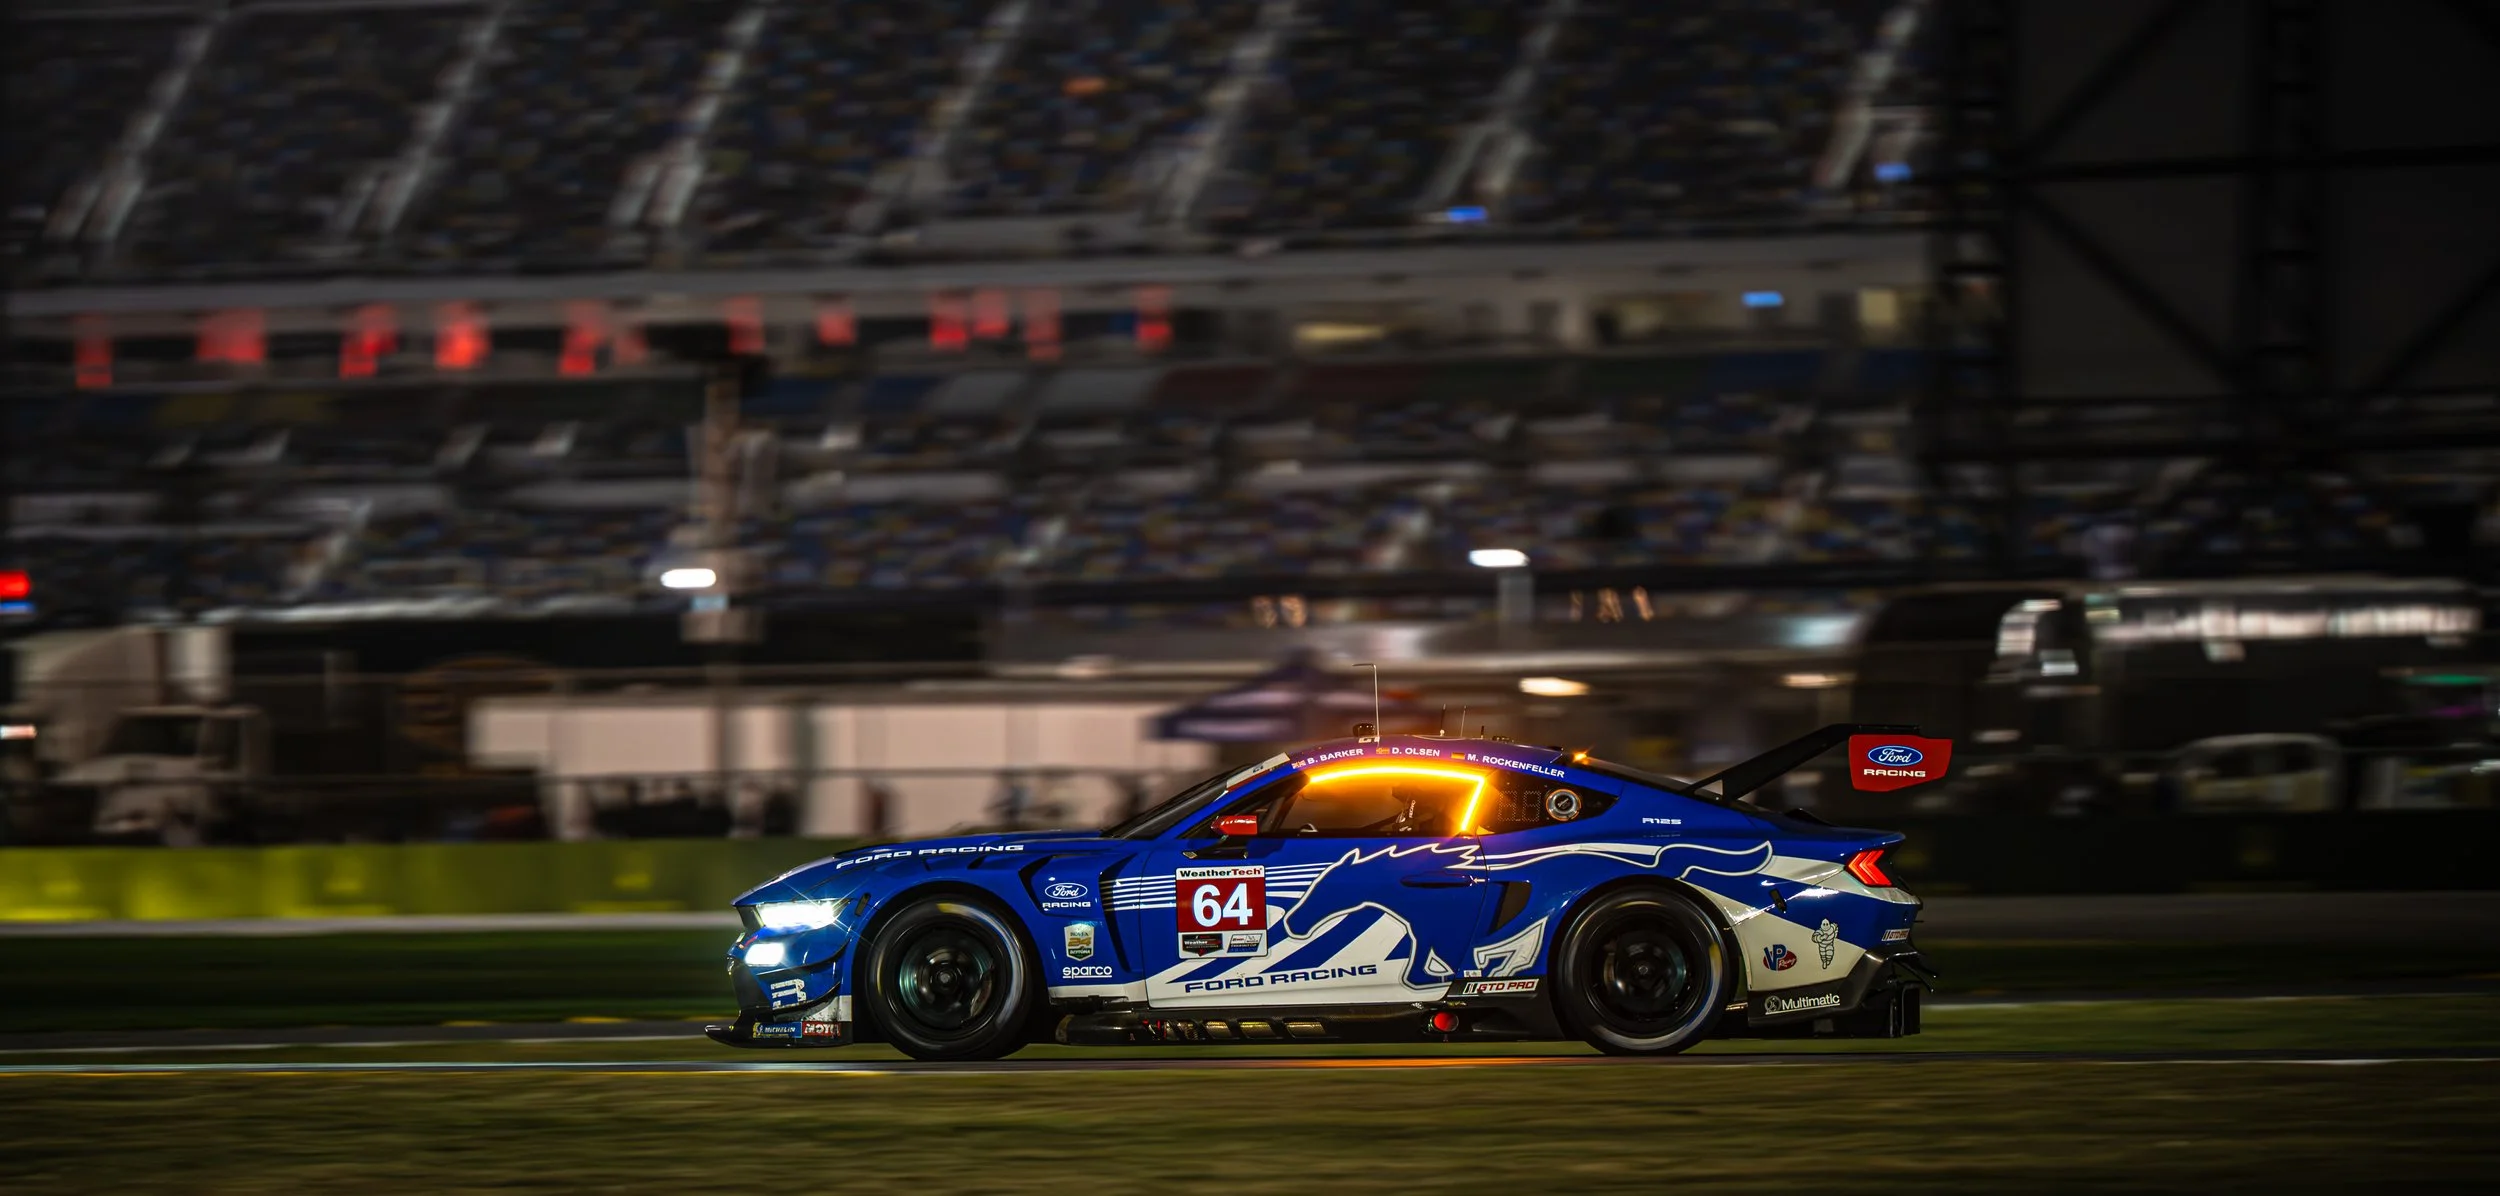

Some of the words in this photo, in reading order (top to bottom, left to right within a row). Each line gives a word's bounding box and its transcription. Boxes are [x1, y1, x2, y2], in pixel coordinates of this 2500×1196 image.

[1307, 756, 1318, 765] B.
[1320, 748, 1364, 763] BARKER
[1392, 747, 1402, 755] D.
[1404, 747, 1440, 757] OLSEN
[1878, 747, 1911, 763] Ford
[1467, 752, 1480, 762] M.
[1481, 755, 1565, 778] ROCKENFELLER
[1863, 768, 1926, 777] RACING
[836, 850, 912, 870] FORD
[918, 844, 1025, 856] RACING
[1179, 868, 1261, 877] WeatherTech
[1052, 885, 1079, 896] Ford
[1193, 882, 1253, 927] 64
[1068, 937, 1092, 947] 24
[1763, 944, 1787, 971] VP
[1062, 965, 1112, 979] sparco
[1185, 976, 1264, 993] FORD
[1271, 964, 1377, 984] RACING
[1478, 982, 1505, 992] GTD
[1507, 981, 1535, 990] PRO
[1781, 993, 1840, 1010] Multimatic
